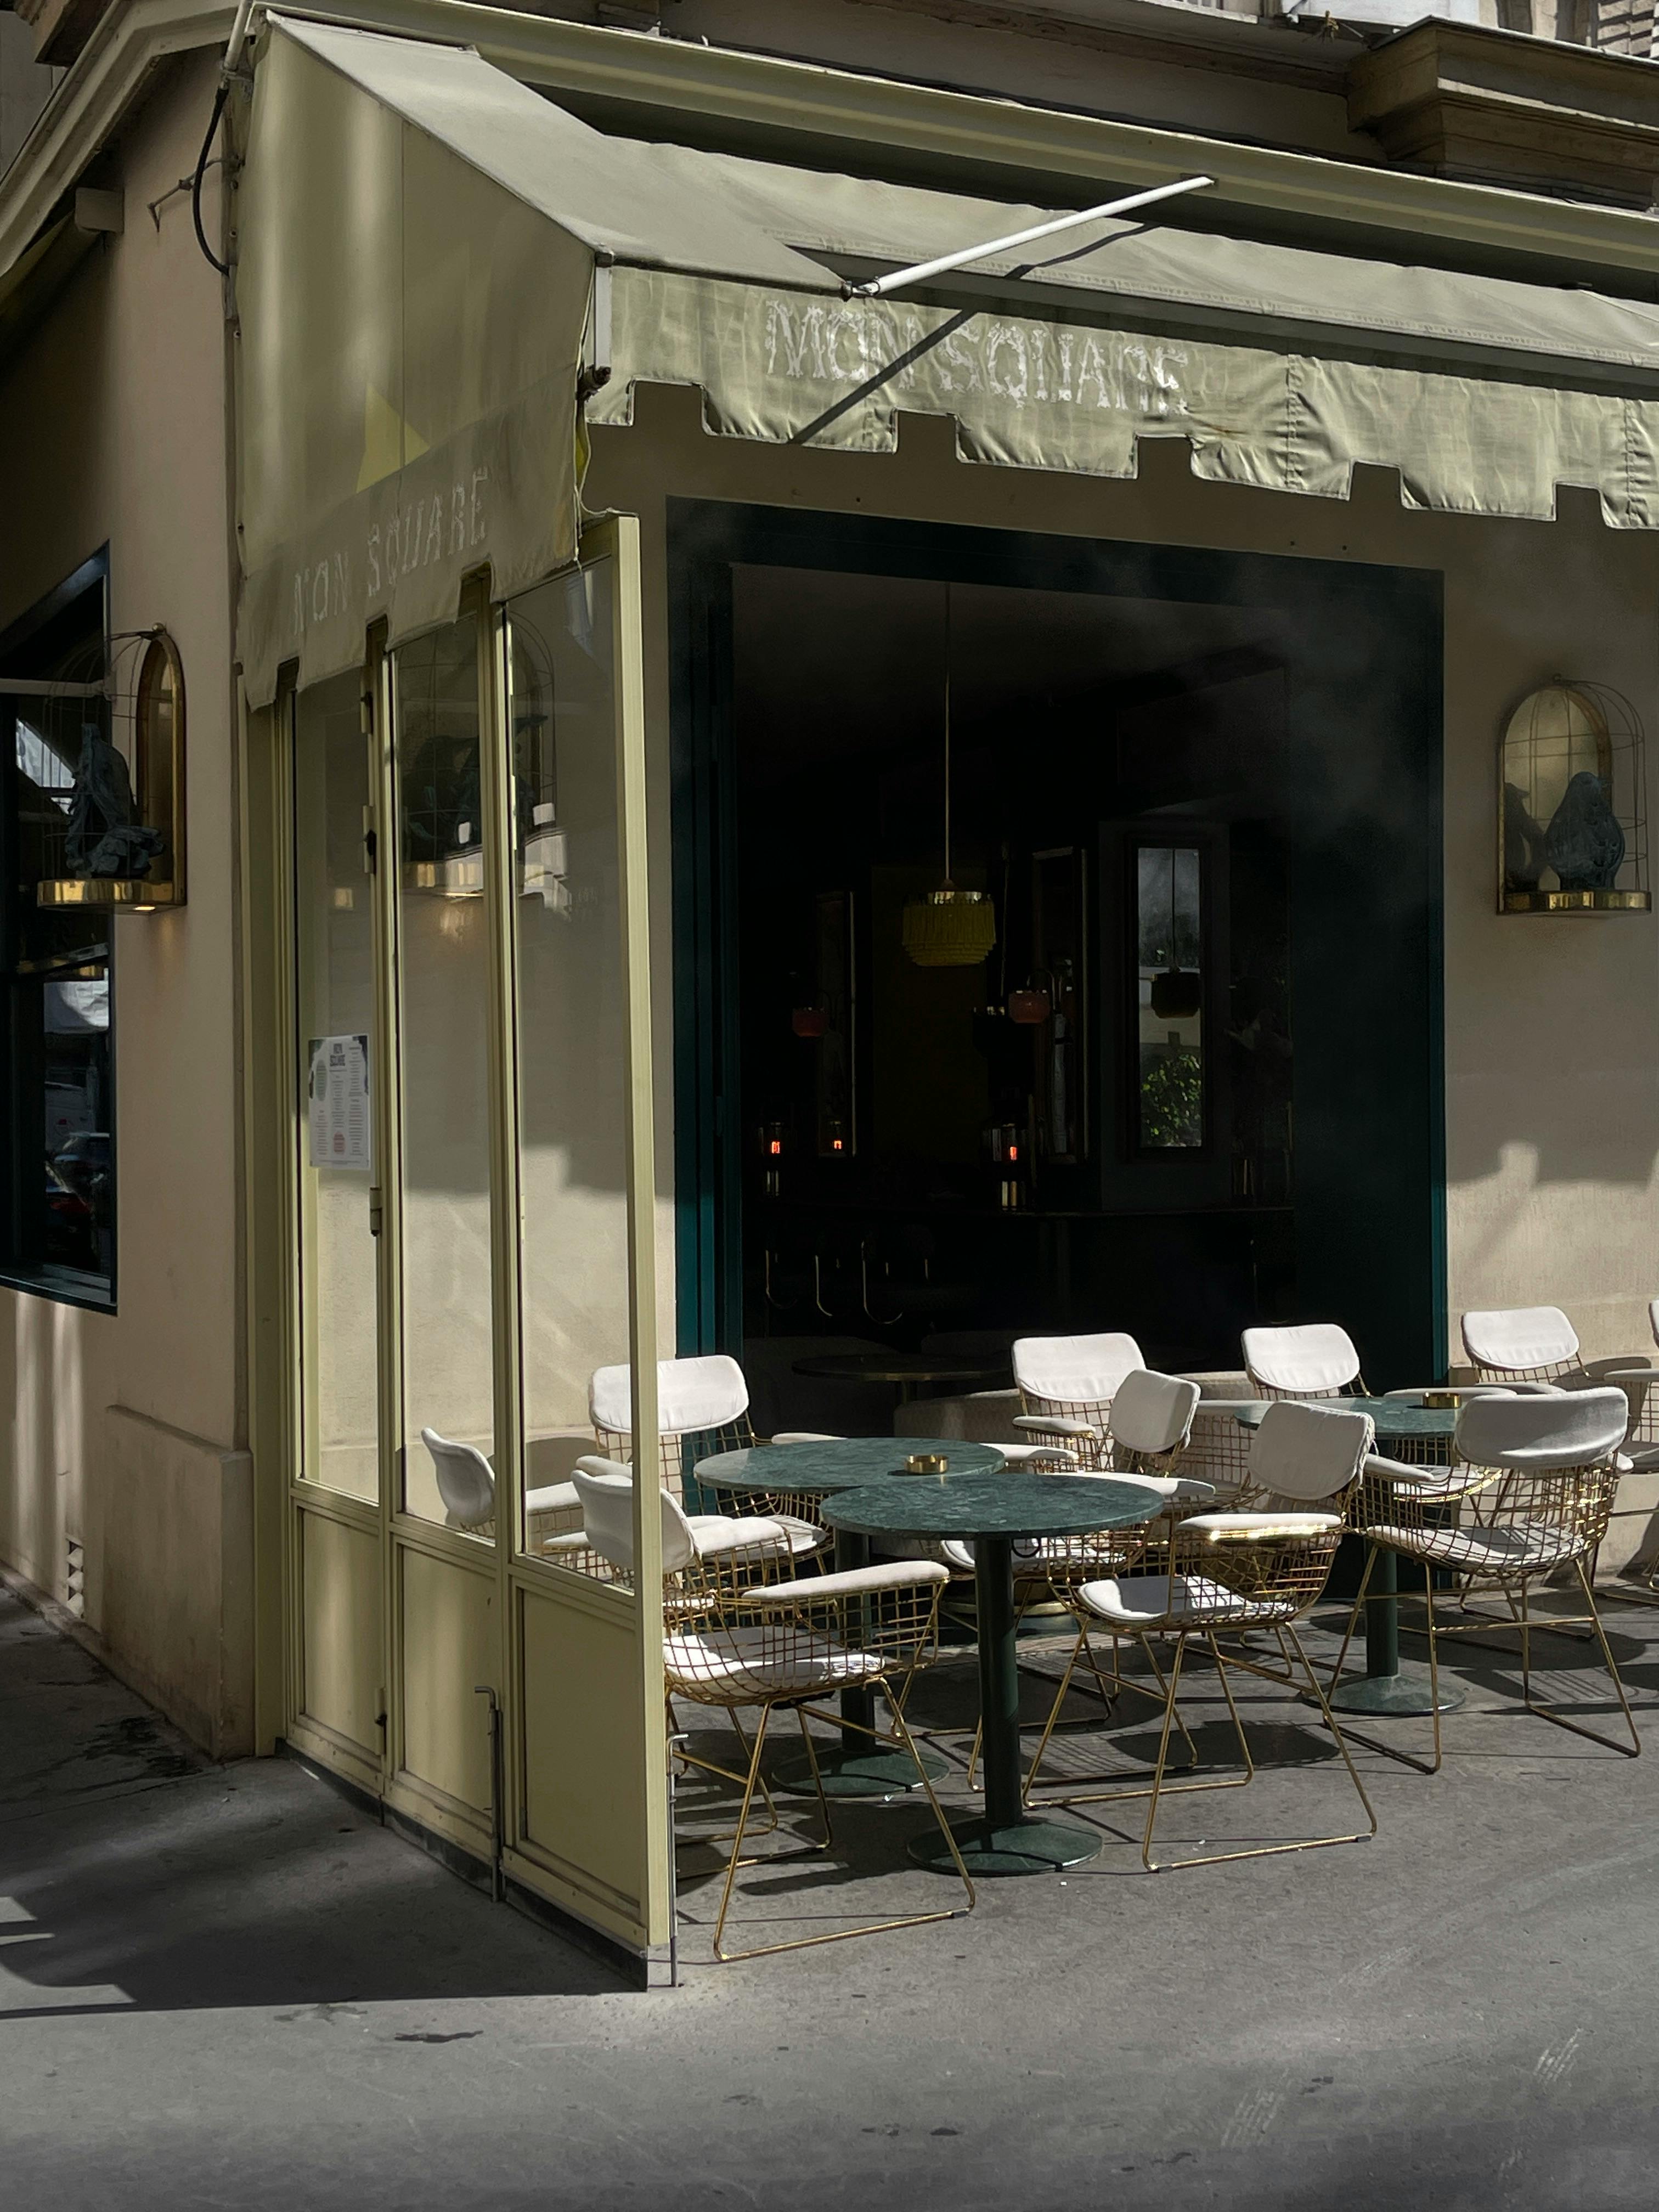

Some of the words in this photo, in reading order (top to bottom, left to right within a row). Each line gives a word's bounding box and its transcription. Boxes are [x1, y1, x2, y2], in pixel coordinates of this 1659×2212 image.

[765, 300, 915, 391] MON
[937, 319, 1188, 415] SQUARE
[368, 466, 489, 597] SQUARE
